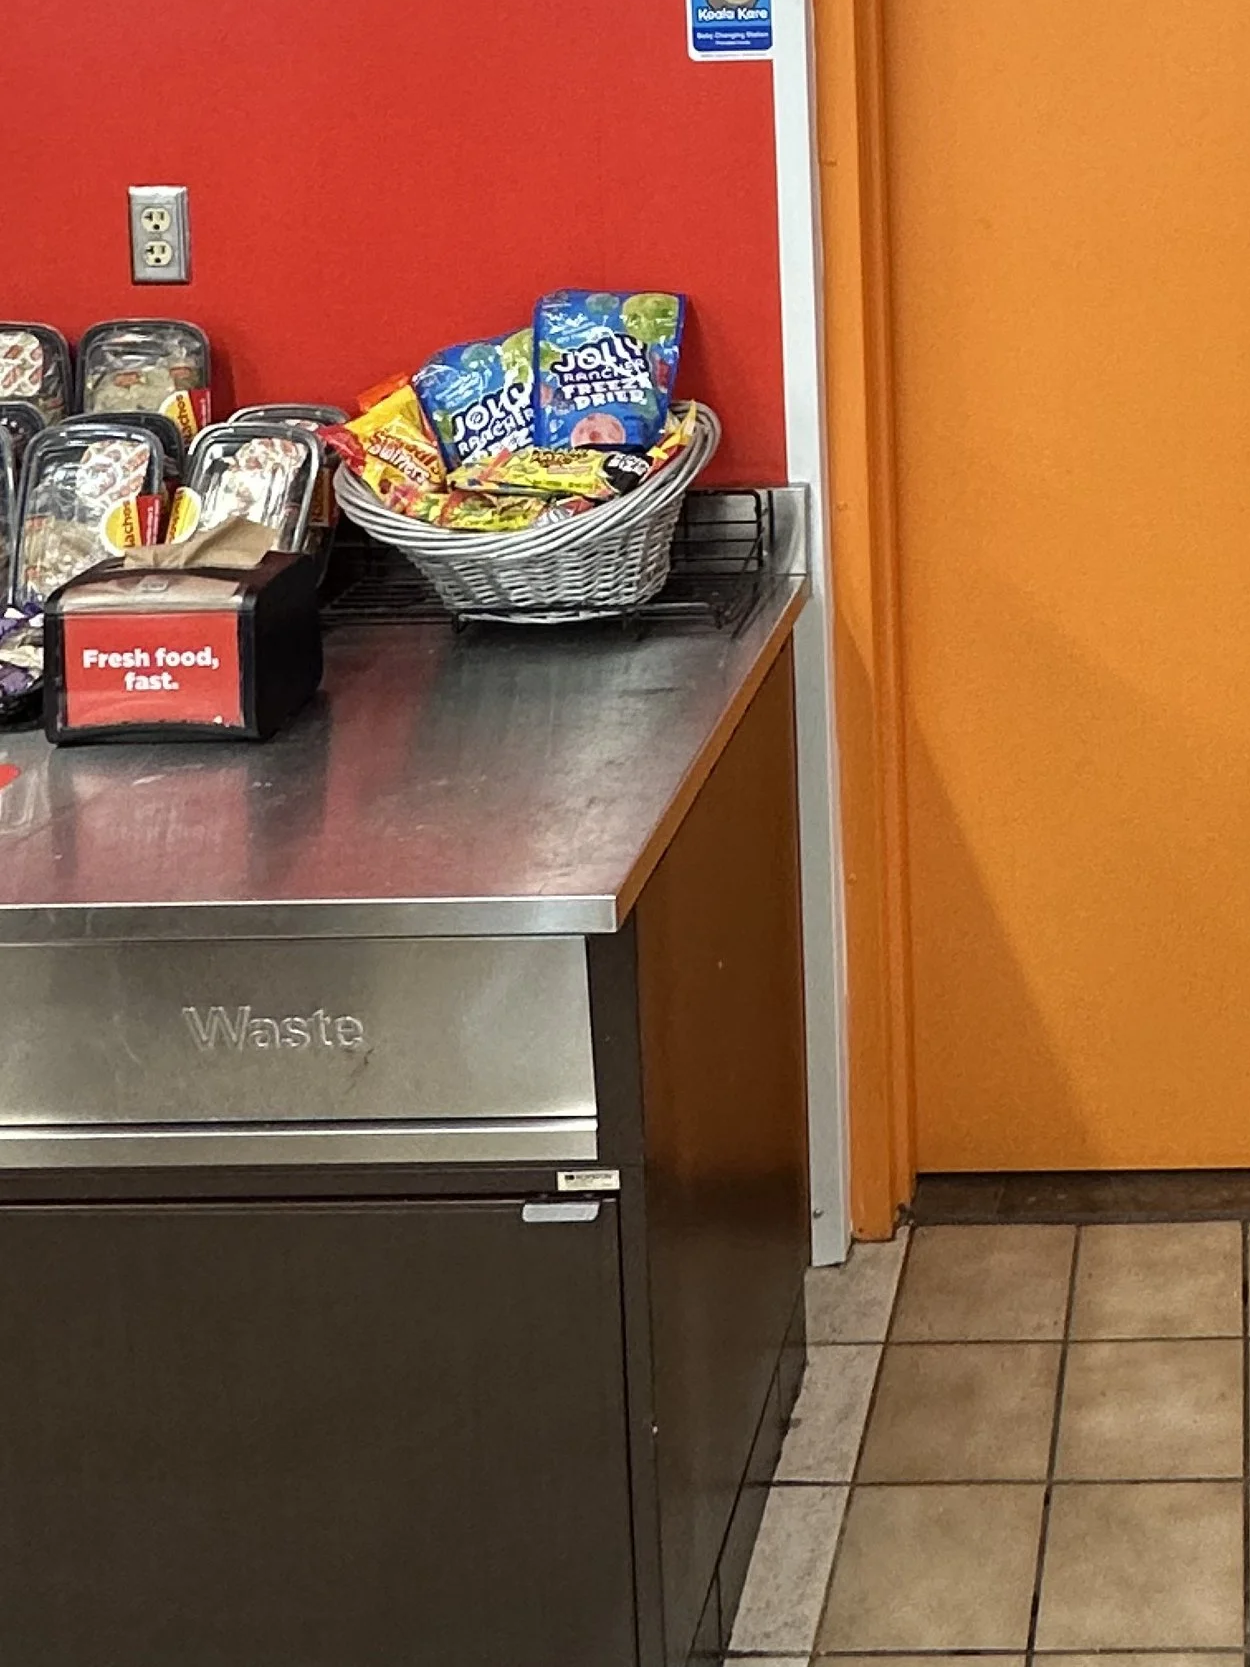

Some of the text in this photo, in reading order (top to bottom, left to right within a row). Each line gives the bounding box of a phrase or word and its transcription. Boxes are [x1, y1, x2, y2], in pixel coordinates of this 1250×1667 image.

[698, 7, 768, 21] Koala Kare
[553, 335, 644, 373] JOLLY
[83, 646, 219, 669] Fresh food,
[124, 671, 179, 692] fast.
[182, 1004, 364, 1051] Waste
